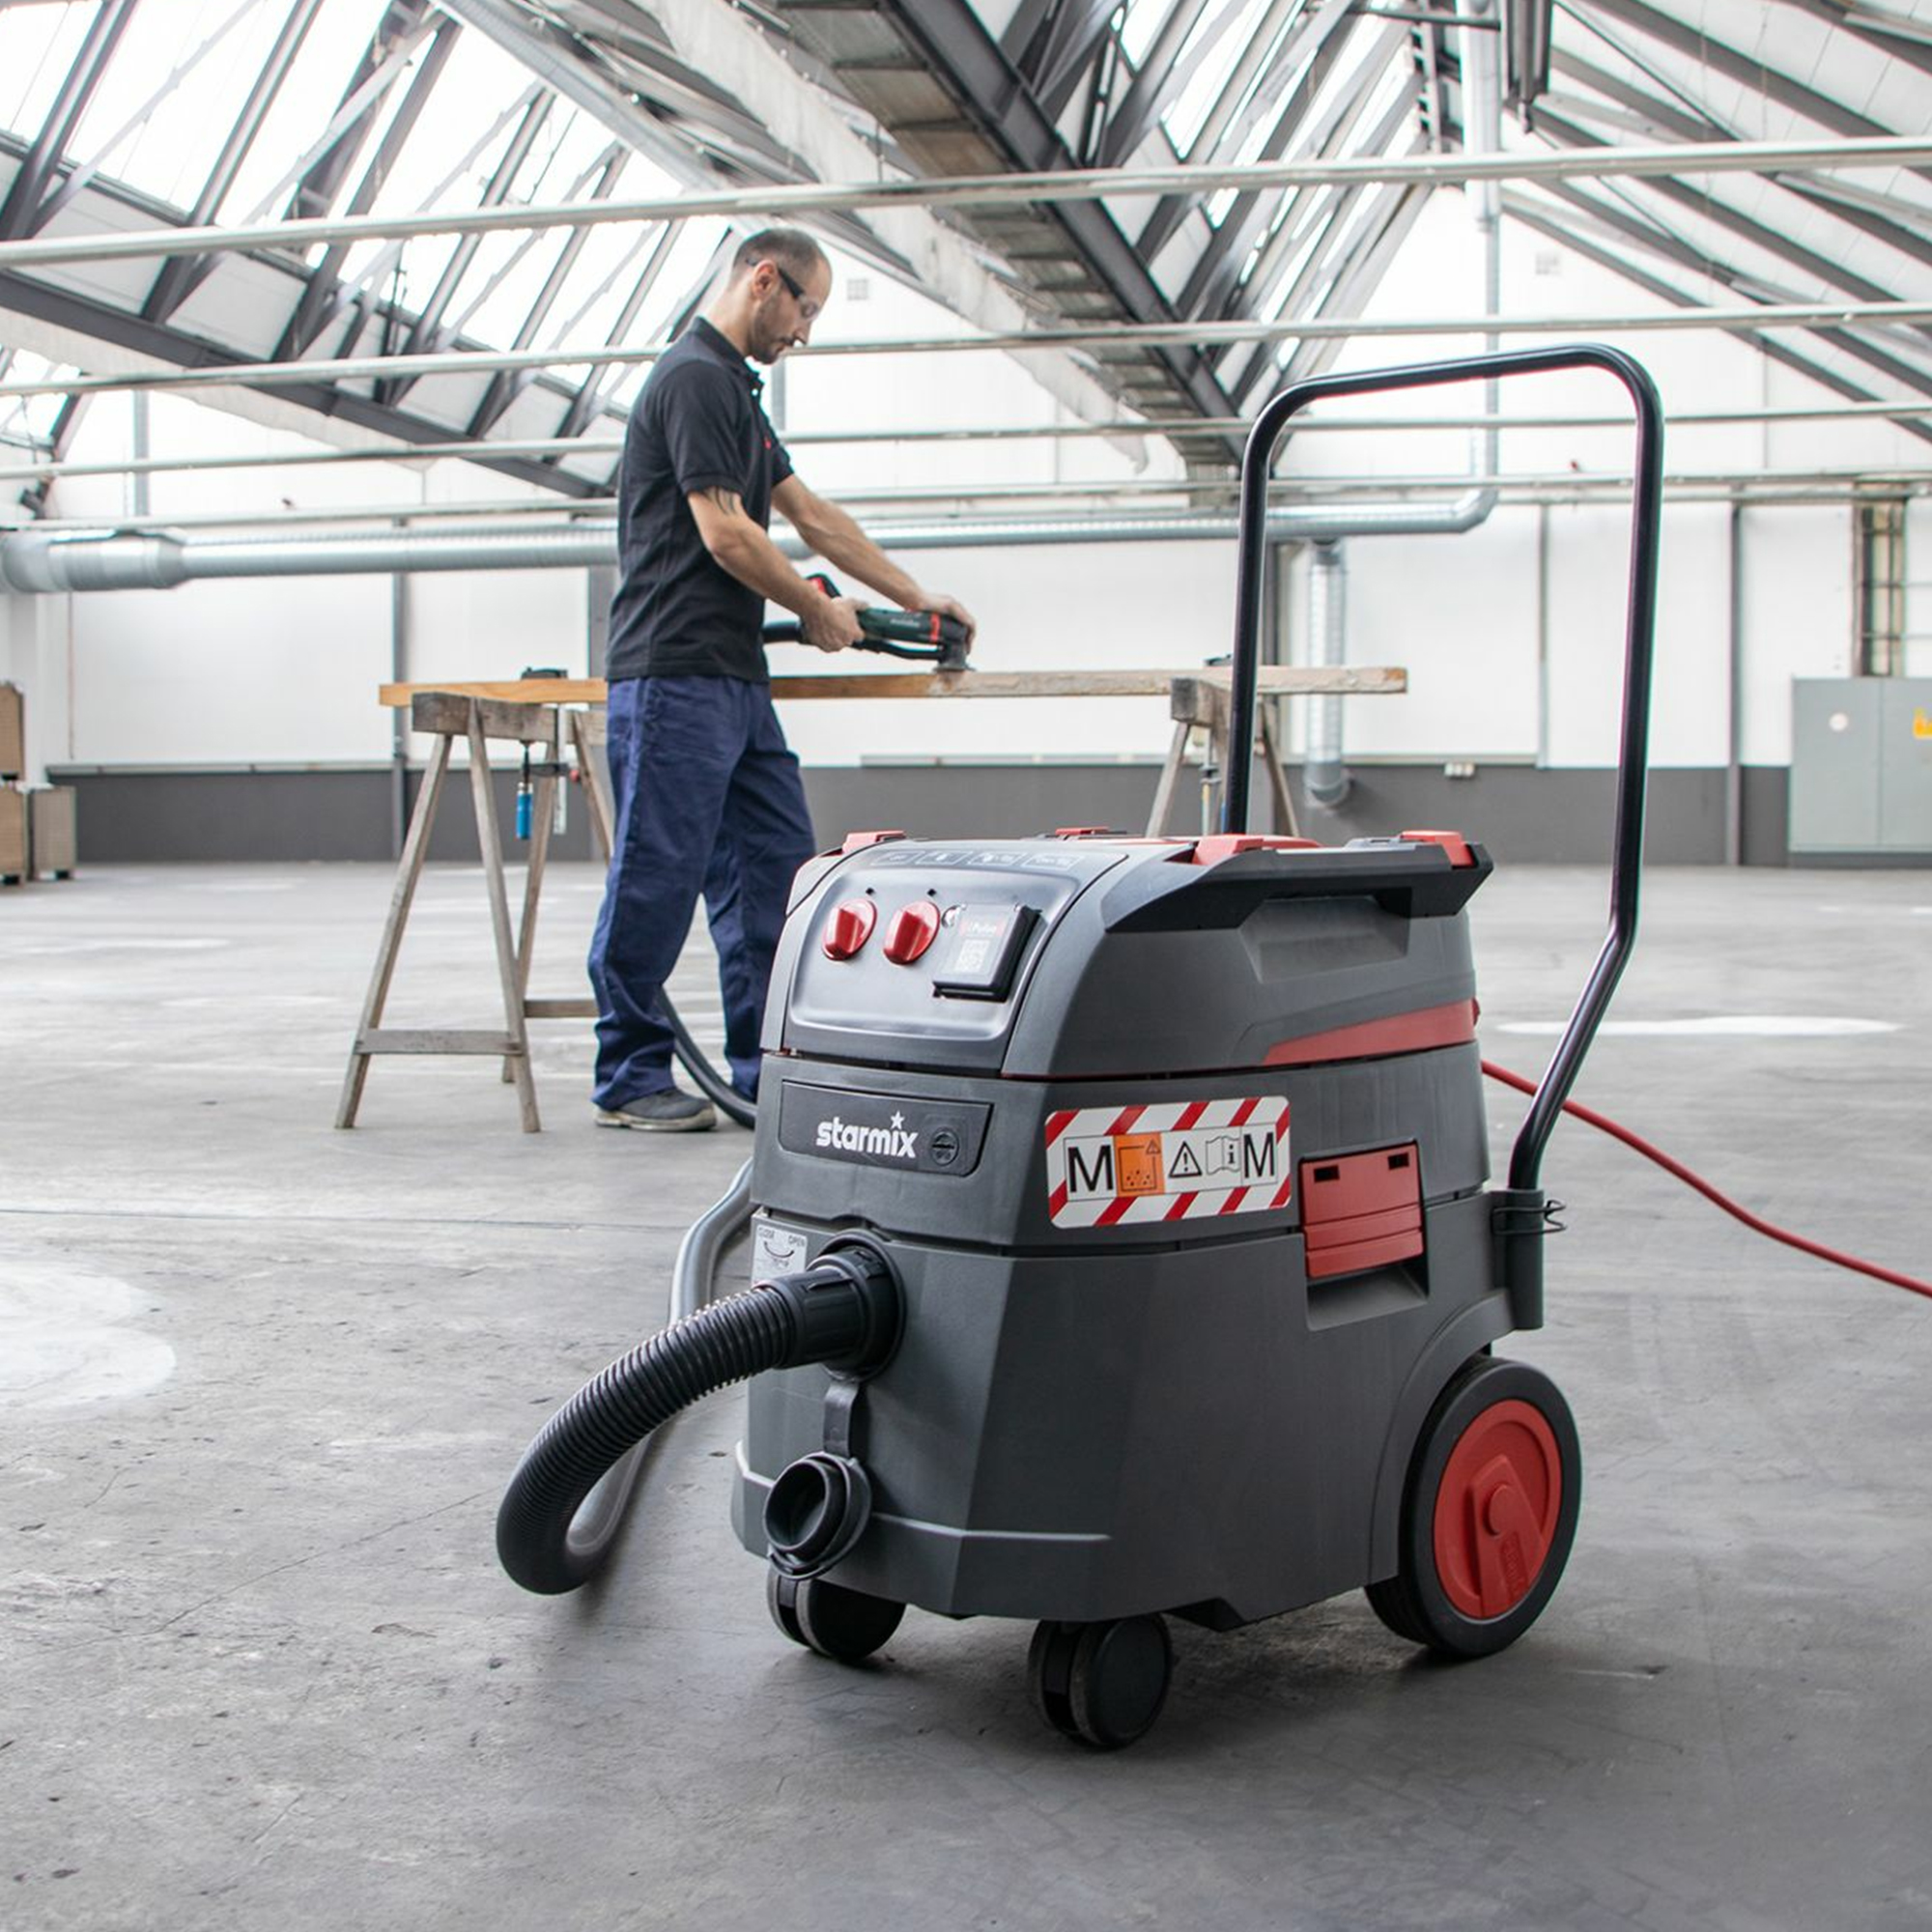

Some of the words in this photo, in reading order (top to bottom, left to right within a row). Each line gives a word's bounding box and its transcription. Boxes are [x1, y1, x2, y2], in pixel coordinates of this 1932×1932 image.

[815, 1110, 919, 1158] starmix
[1067, 1144, 1114, 1192] M
[1243, 1131, 1275, 1179] M
